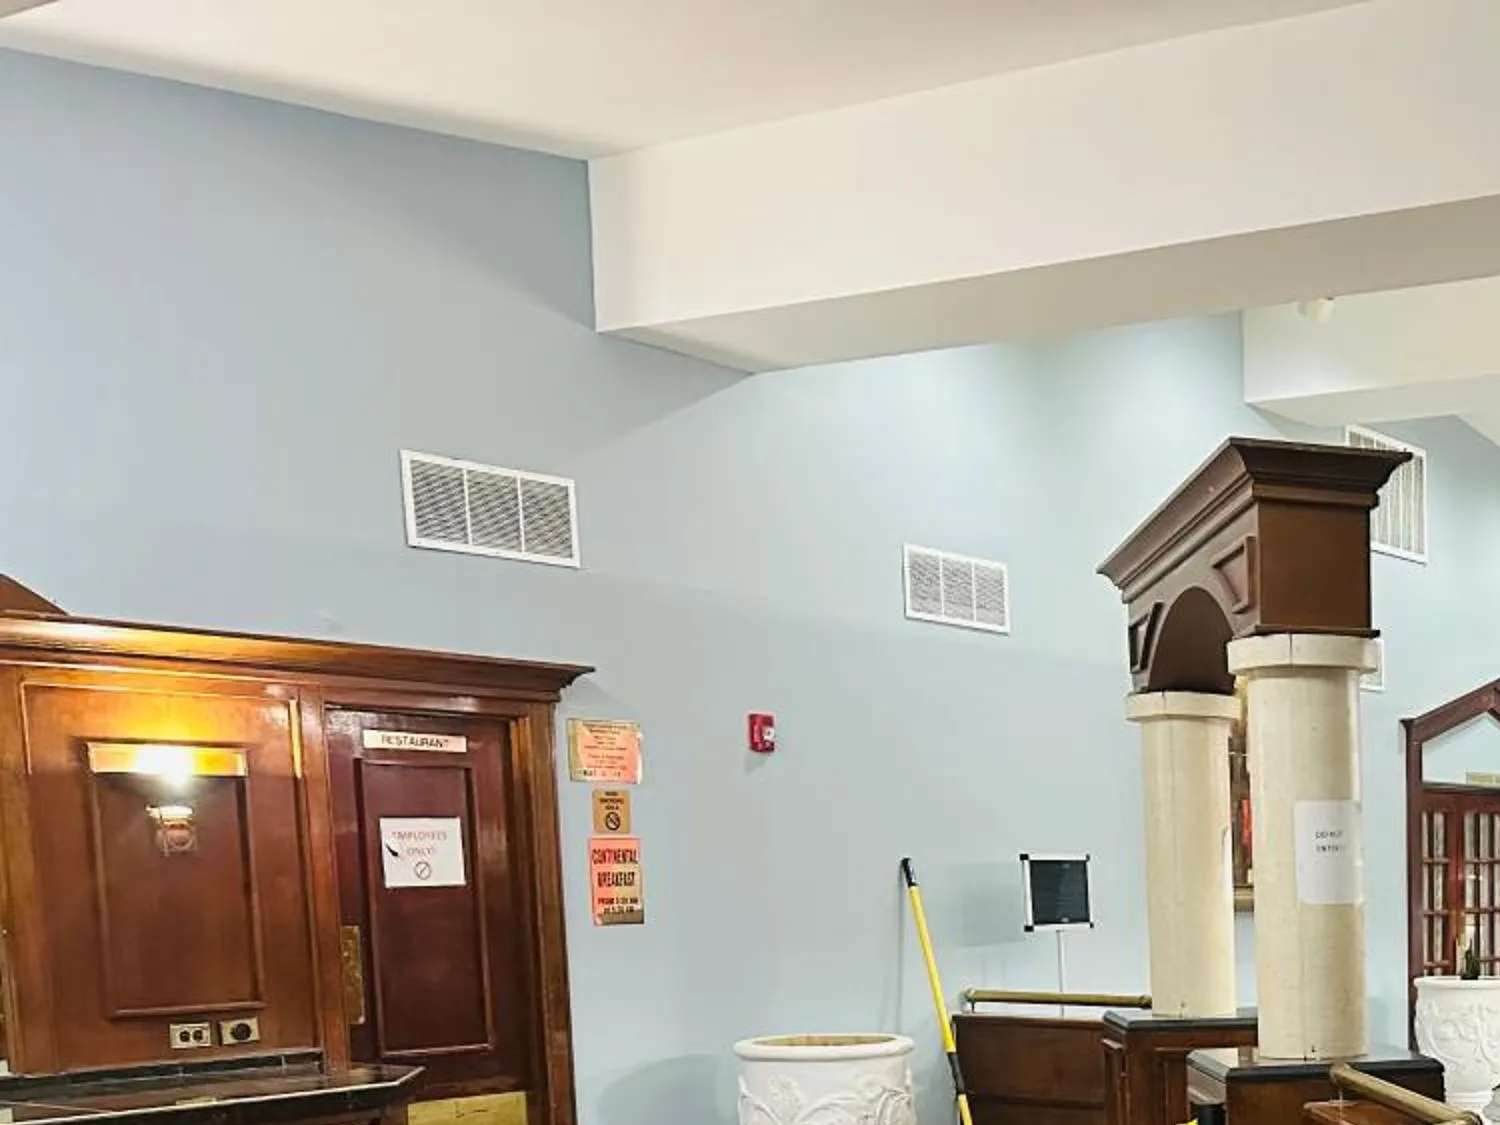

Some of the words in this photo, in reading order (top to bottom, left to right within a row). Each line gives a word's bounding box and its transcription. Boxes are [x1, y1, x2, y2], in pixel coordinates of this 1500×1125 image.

[381, 734, 449, 748] RESTAURANT
[592, 848, 638, 864] CONTINENTAL
[598, 871, 635, 887] BREAKFAST
